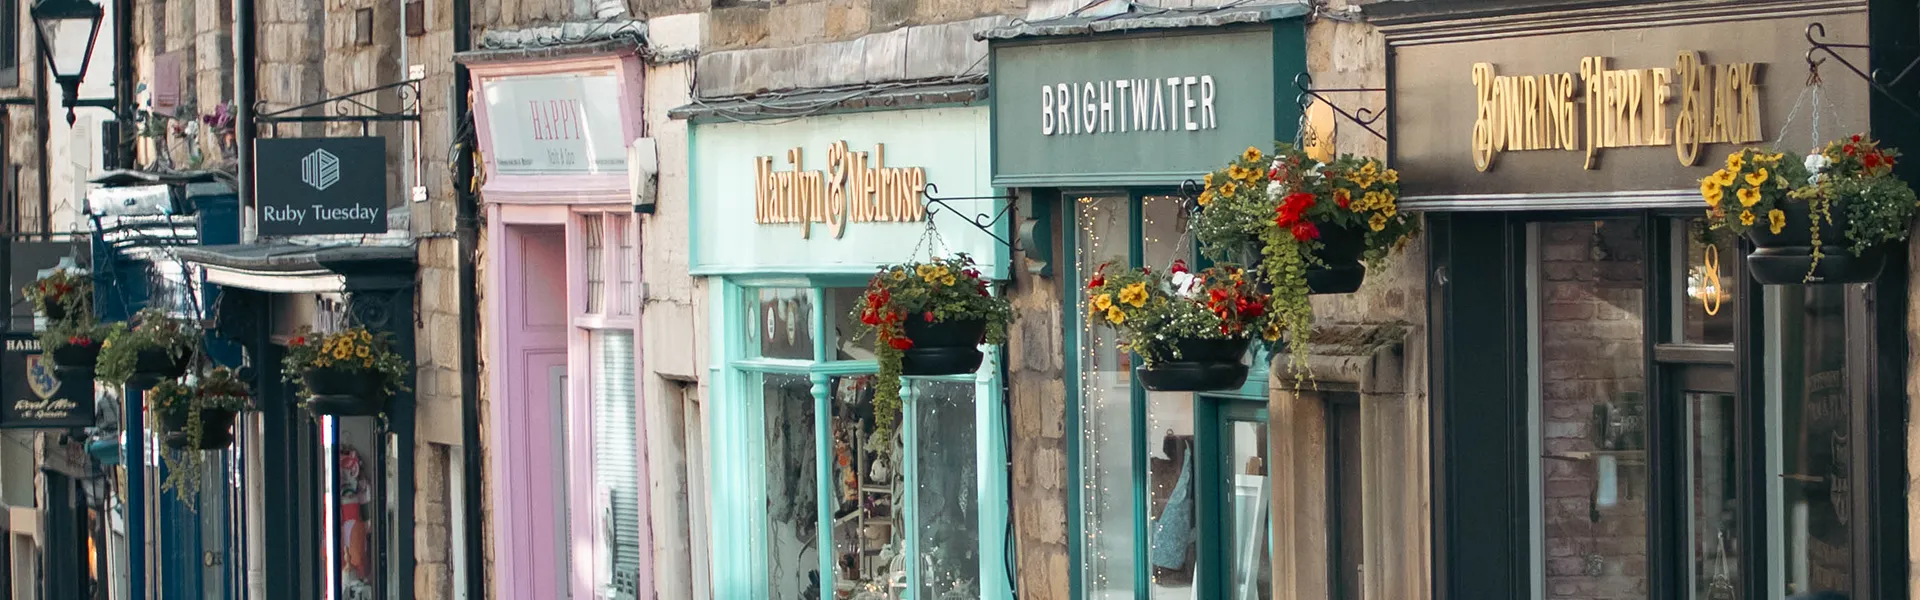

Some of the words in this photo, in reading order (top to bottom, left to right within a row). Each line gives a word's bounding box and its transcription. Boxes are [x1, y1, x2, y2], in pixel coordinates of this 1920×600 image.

[529, 99, 580, 140] HAPPY
[1042, 75, 1217, 136] BRIGHTWATER
[1472, 62, 1580, 172] BOWRING
[1675, 50, 1767, 166] BLACK
[264, 204, 306, 226] Ruby
[311, 202, 379, 224] Tuesday
[753, 146, 827, 240] Marilyn
[825, 140, 849, 240] &
[847, 143, 927, 223] Melrose
[1703, 243, 1721, 316] 8
